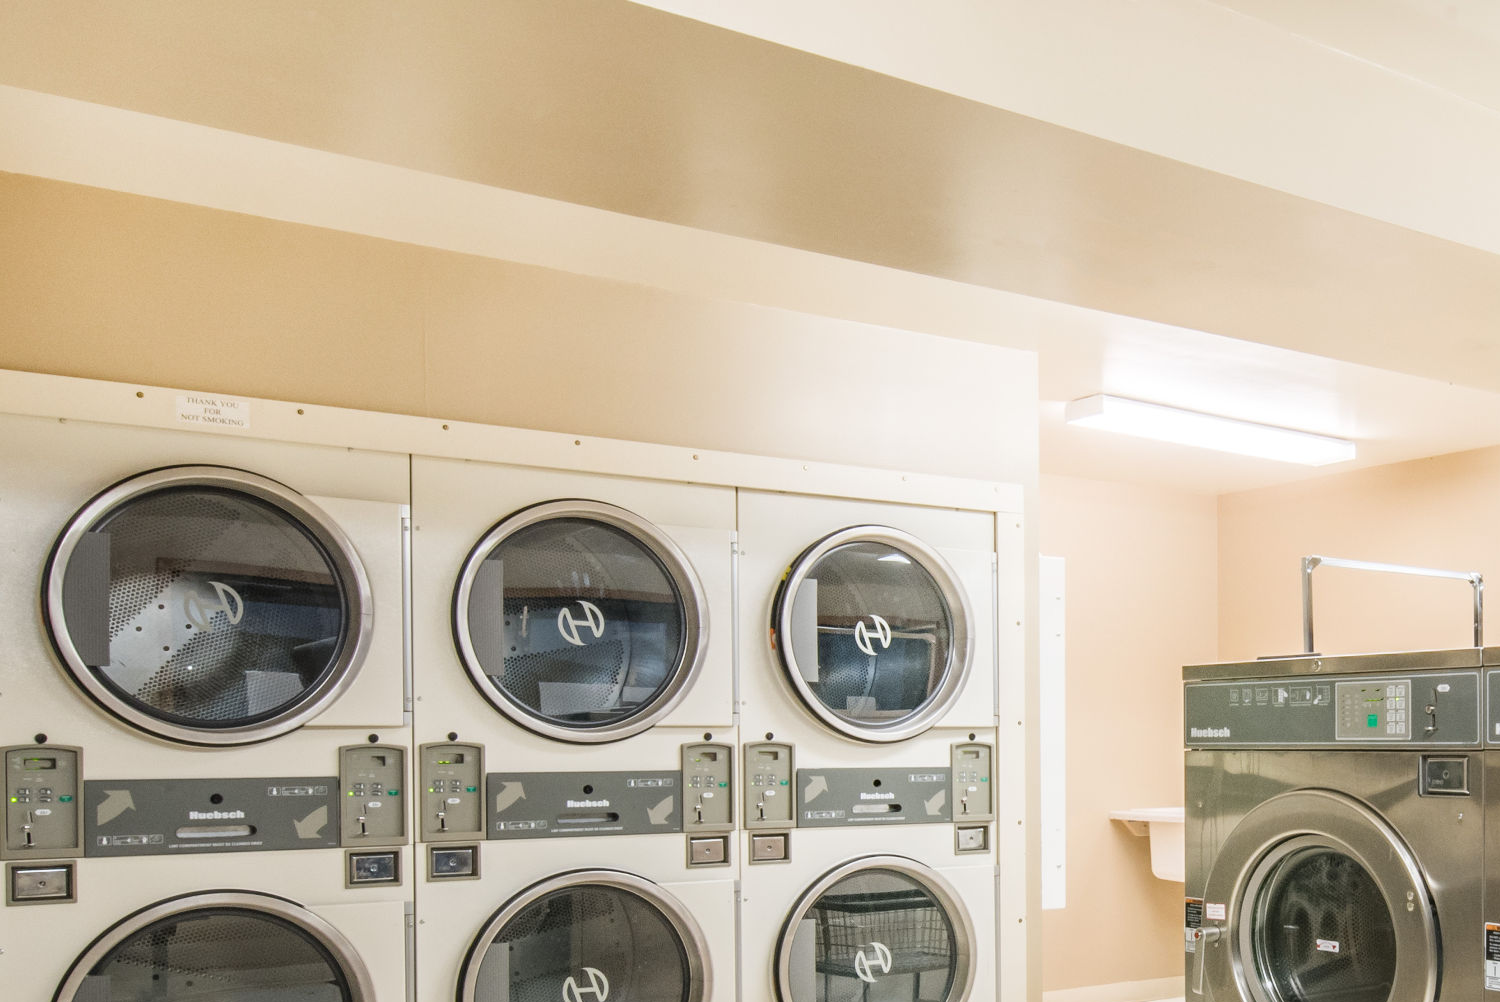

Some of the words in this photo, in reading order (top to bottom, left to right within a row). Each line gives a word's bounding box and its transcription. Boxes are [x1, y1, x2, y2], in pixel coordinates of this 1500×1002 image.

[187, 397, 217, 406] THANK
[220, 400, 239, 409] YOU
[204, 407, 222, 415] FOR
[181, 413, 201, 421] NOT
[202, 416, 244, 426] SMOKING
[1190, 726, 1231, 738] Huebsch
[566, 799, 610, 808] Huebsch
[189, 810, 245, 820] Huebsch
